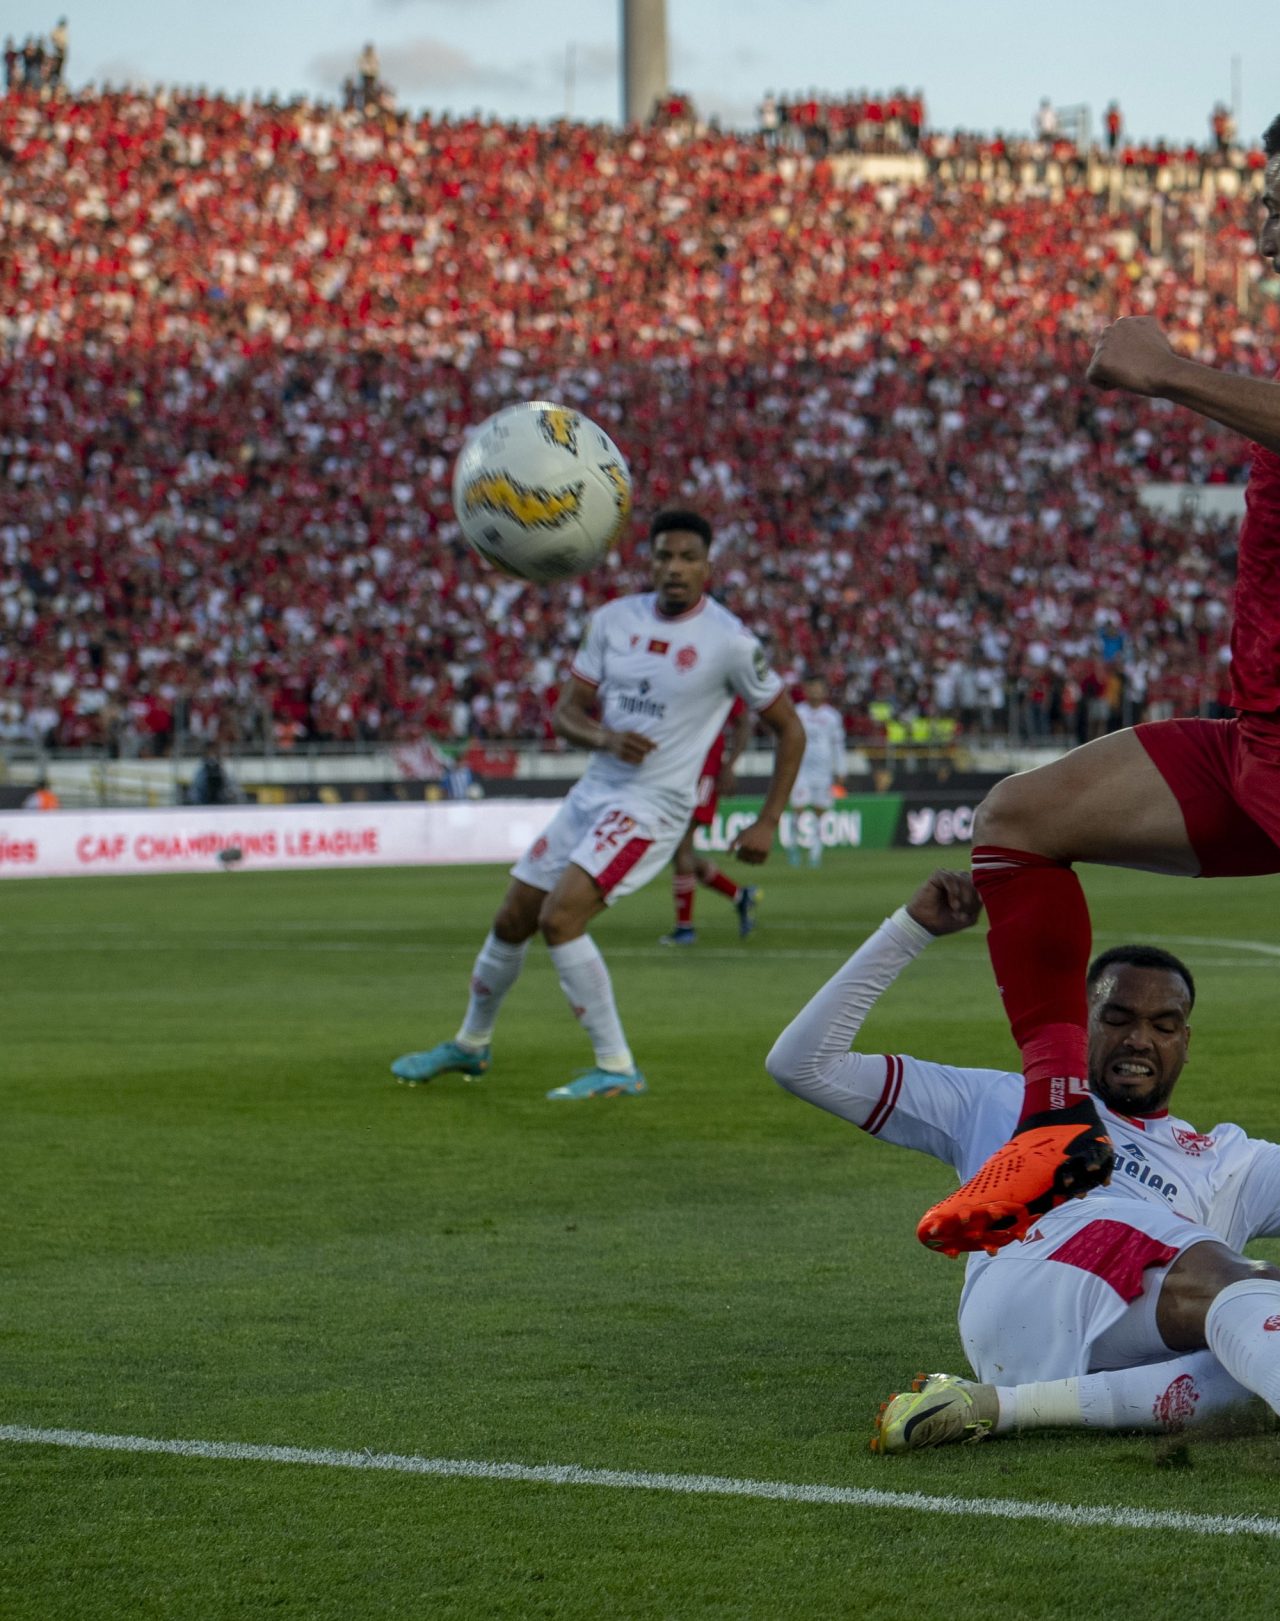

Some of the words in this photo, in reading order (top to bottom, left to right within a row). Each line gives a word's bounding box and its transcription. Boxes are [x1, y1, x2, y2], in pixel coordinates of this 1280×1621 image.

[76, 834, 126, 865] CAF
[134, 829, 277, 863] CHAMPIONS
[284, 826, 379, 857] LEAGUE
[594, 809, 636, 848] 22
[820, 809, 862, 848] ON
